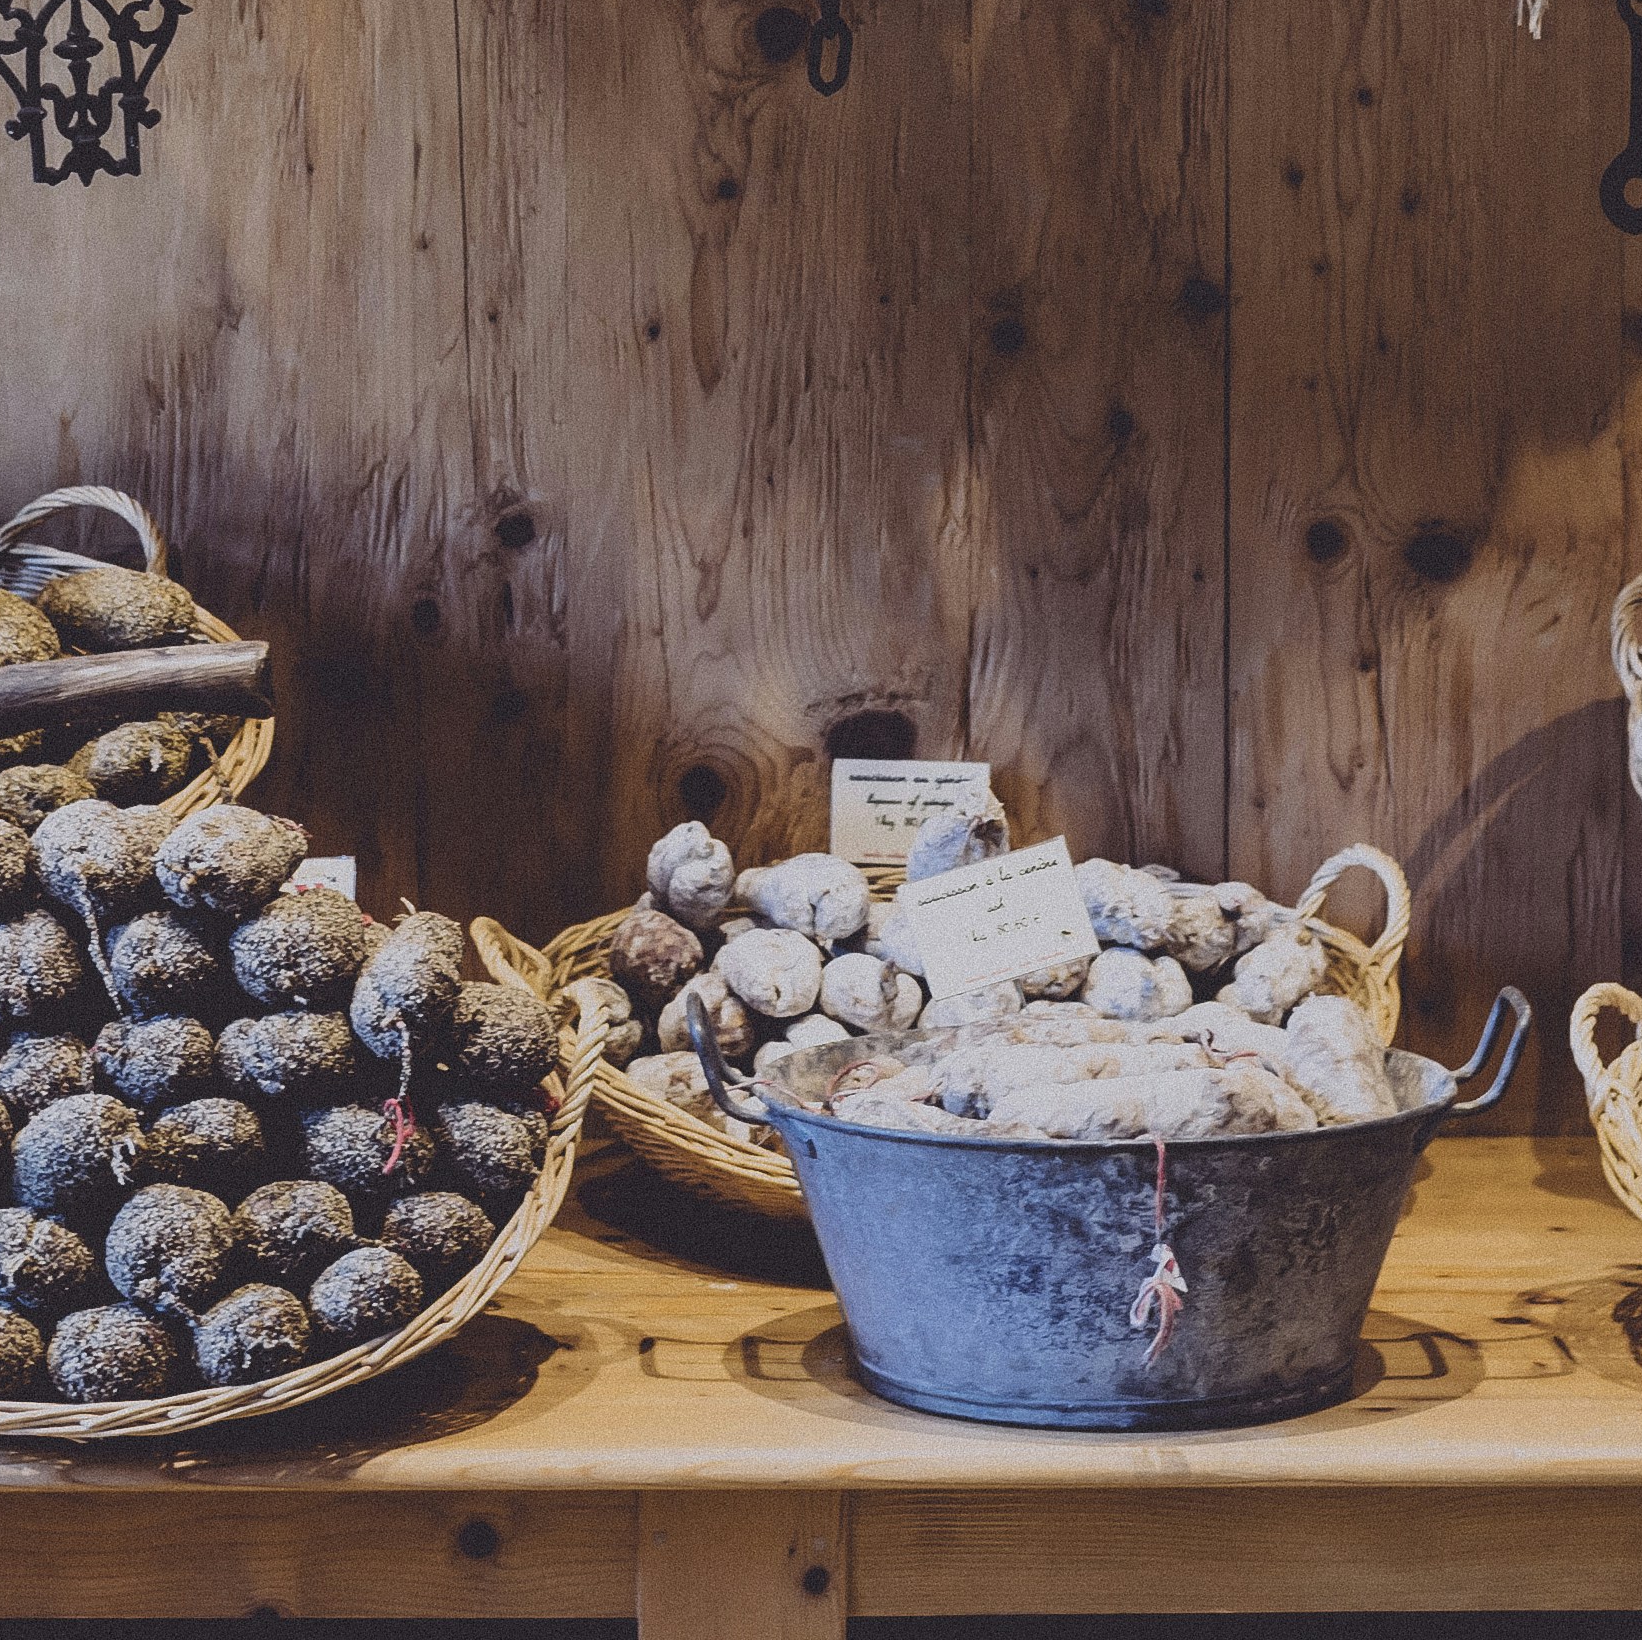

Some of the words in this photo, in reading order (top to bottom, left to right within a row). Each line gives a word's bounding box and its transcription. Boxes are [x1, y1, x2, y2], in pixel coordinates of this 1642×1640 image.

[917, 883, 980, 907] saucisson
[985, 874, 994, 886] à
[998, 866, 1013, 882] la
